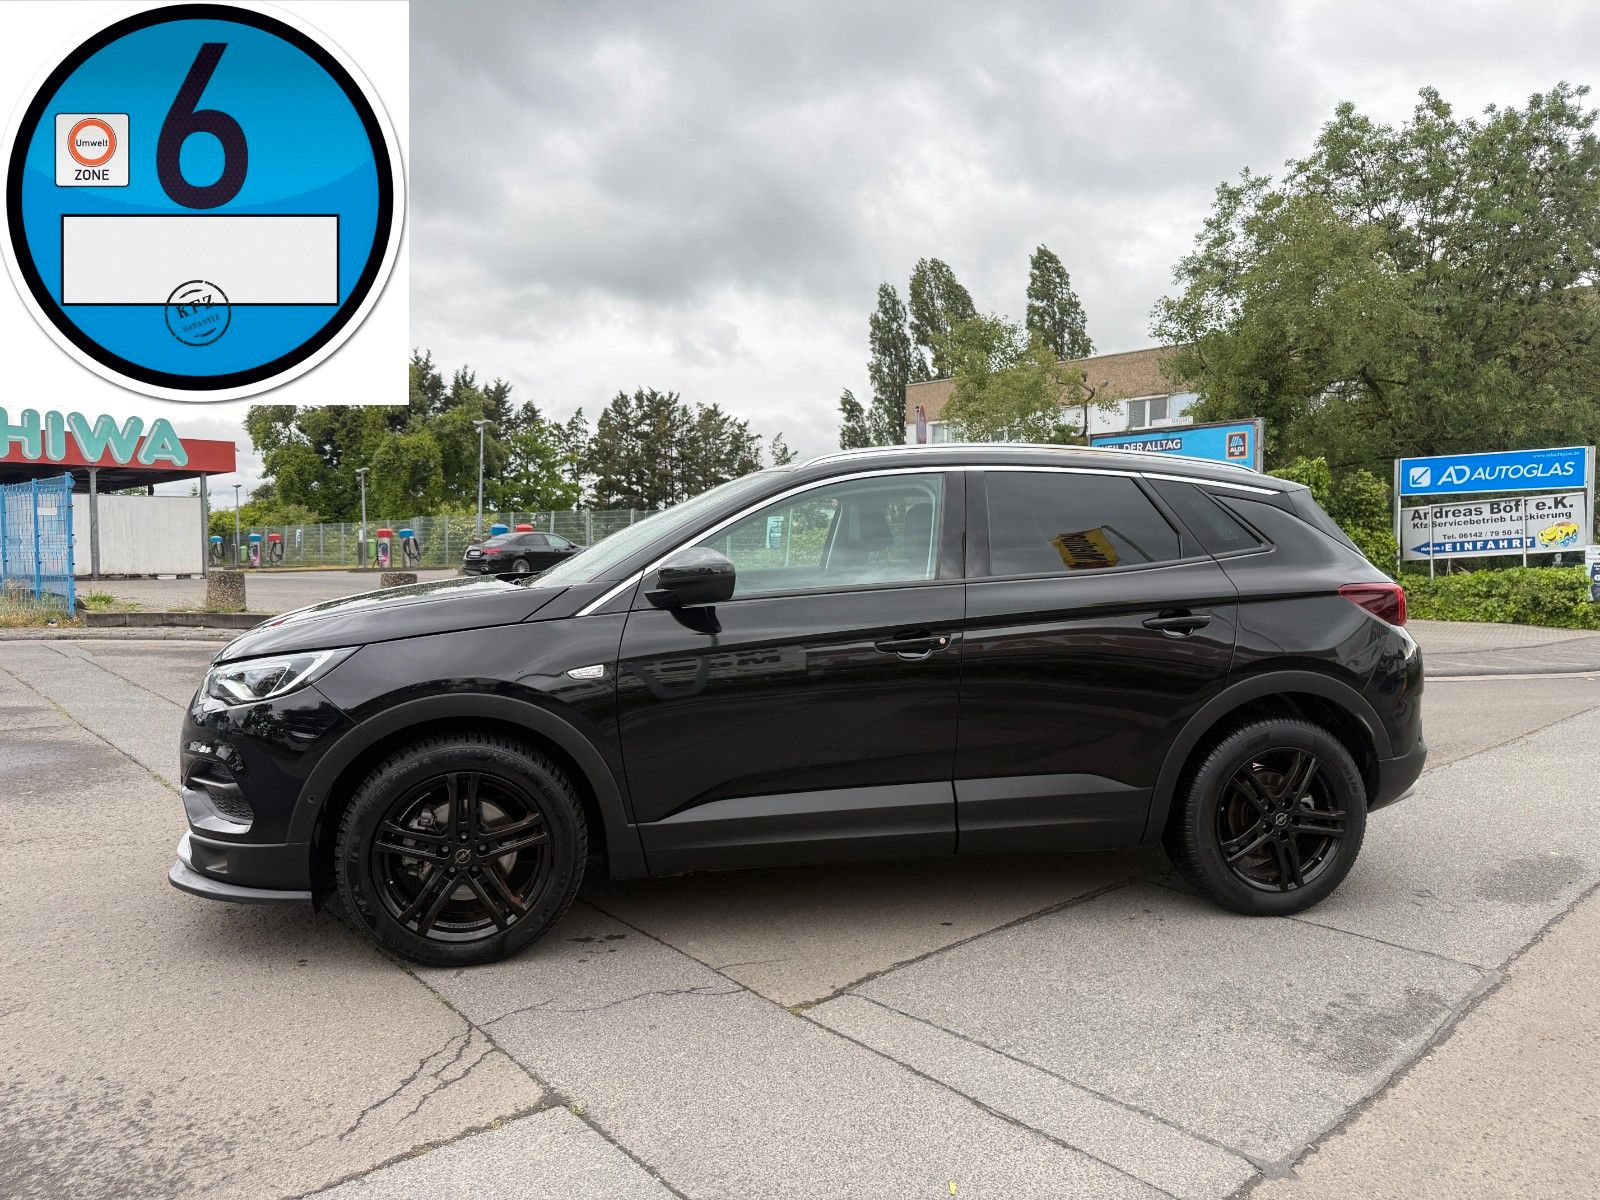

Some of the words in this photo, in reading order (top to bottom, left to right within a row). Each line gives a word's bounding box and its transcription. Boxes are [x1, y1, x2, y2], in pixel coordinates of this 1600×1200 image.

[1123, 443, 1143, 451] DER
[1145, 439, 1181, 452] ALLTAG
[1437, 465, 1471, 486] AD
[1471, 461, 1576, 481] AUTOGLAS
[1535, 496, 1574, 511] e.K.
[1459, 531, 1483, 539] 06142
[1445, 538, 1533, 552] EINFAHRT
